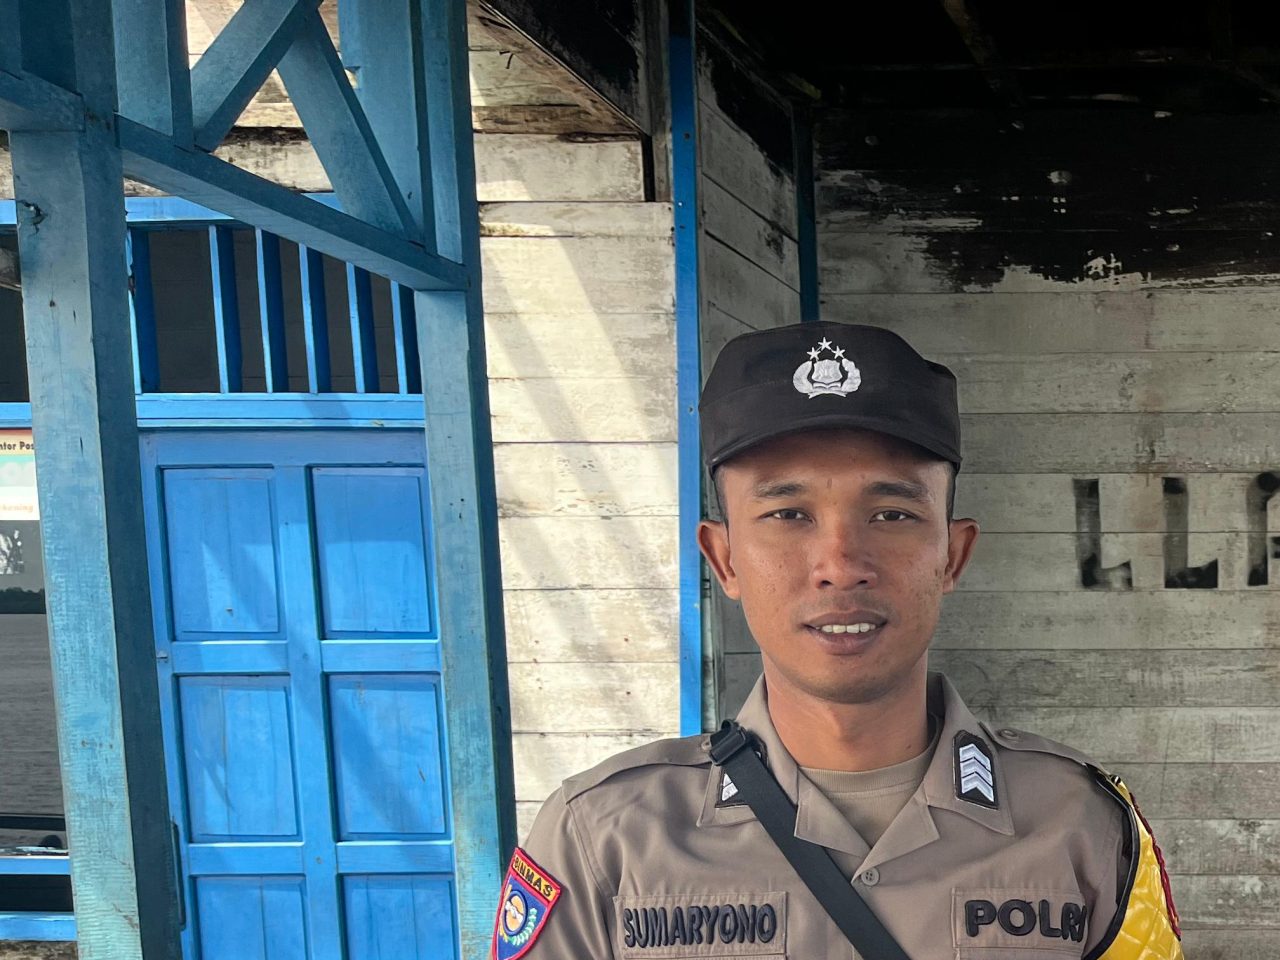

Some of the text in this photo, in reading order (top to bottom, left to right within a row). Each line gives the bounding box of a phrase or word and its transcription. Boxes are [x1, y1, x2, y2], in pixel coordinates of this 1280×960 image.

[514, 857, 553, 898] BINMAS
[623, 903, 777, 948] SUMARYONO
[965, 899, 1087, 942] POLRI
